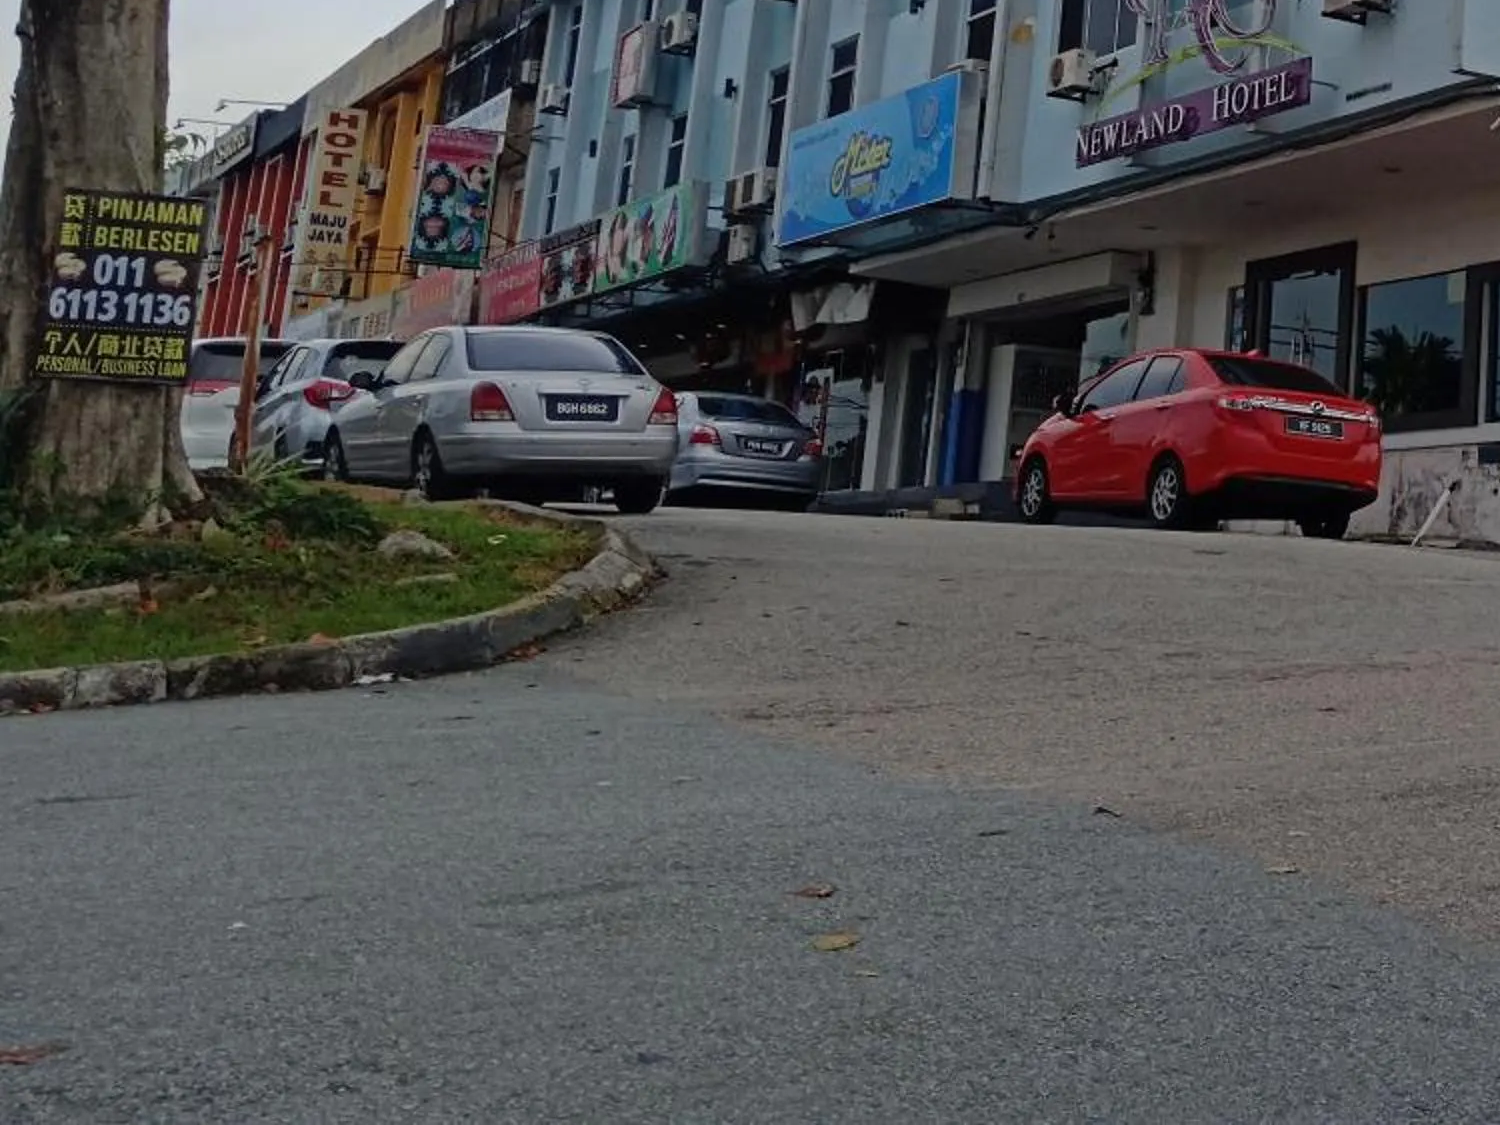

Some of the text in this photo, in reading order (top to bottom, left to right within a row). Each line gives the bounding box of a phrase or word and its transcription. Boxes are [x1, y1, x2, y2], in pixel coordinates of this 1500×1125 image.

[1076, 71, 1296, 159] NEWLAND HOTEL
[319, 111, 359, 207] HOTEL
[97, 197, 204, 226] PINJAMAN
[309, 213, 348, 229] MAJU
[93, 226, 200, 254] BERLESEN
[307, 229, 343, 245] JAYA
[93, 254, 146, 288] 011
[49, 286, 192, 326] 6113 1136
[157, 361, 187, 377] LOAN
